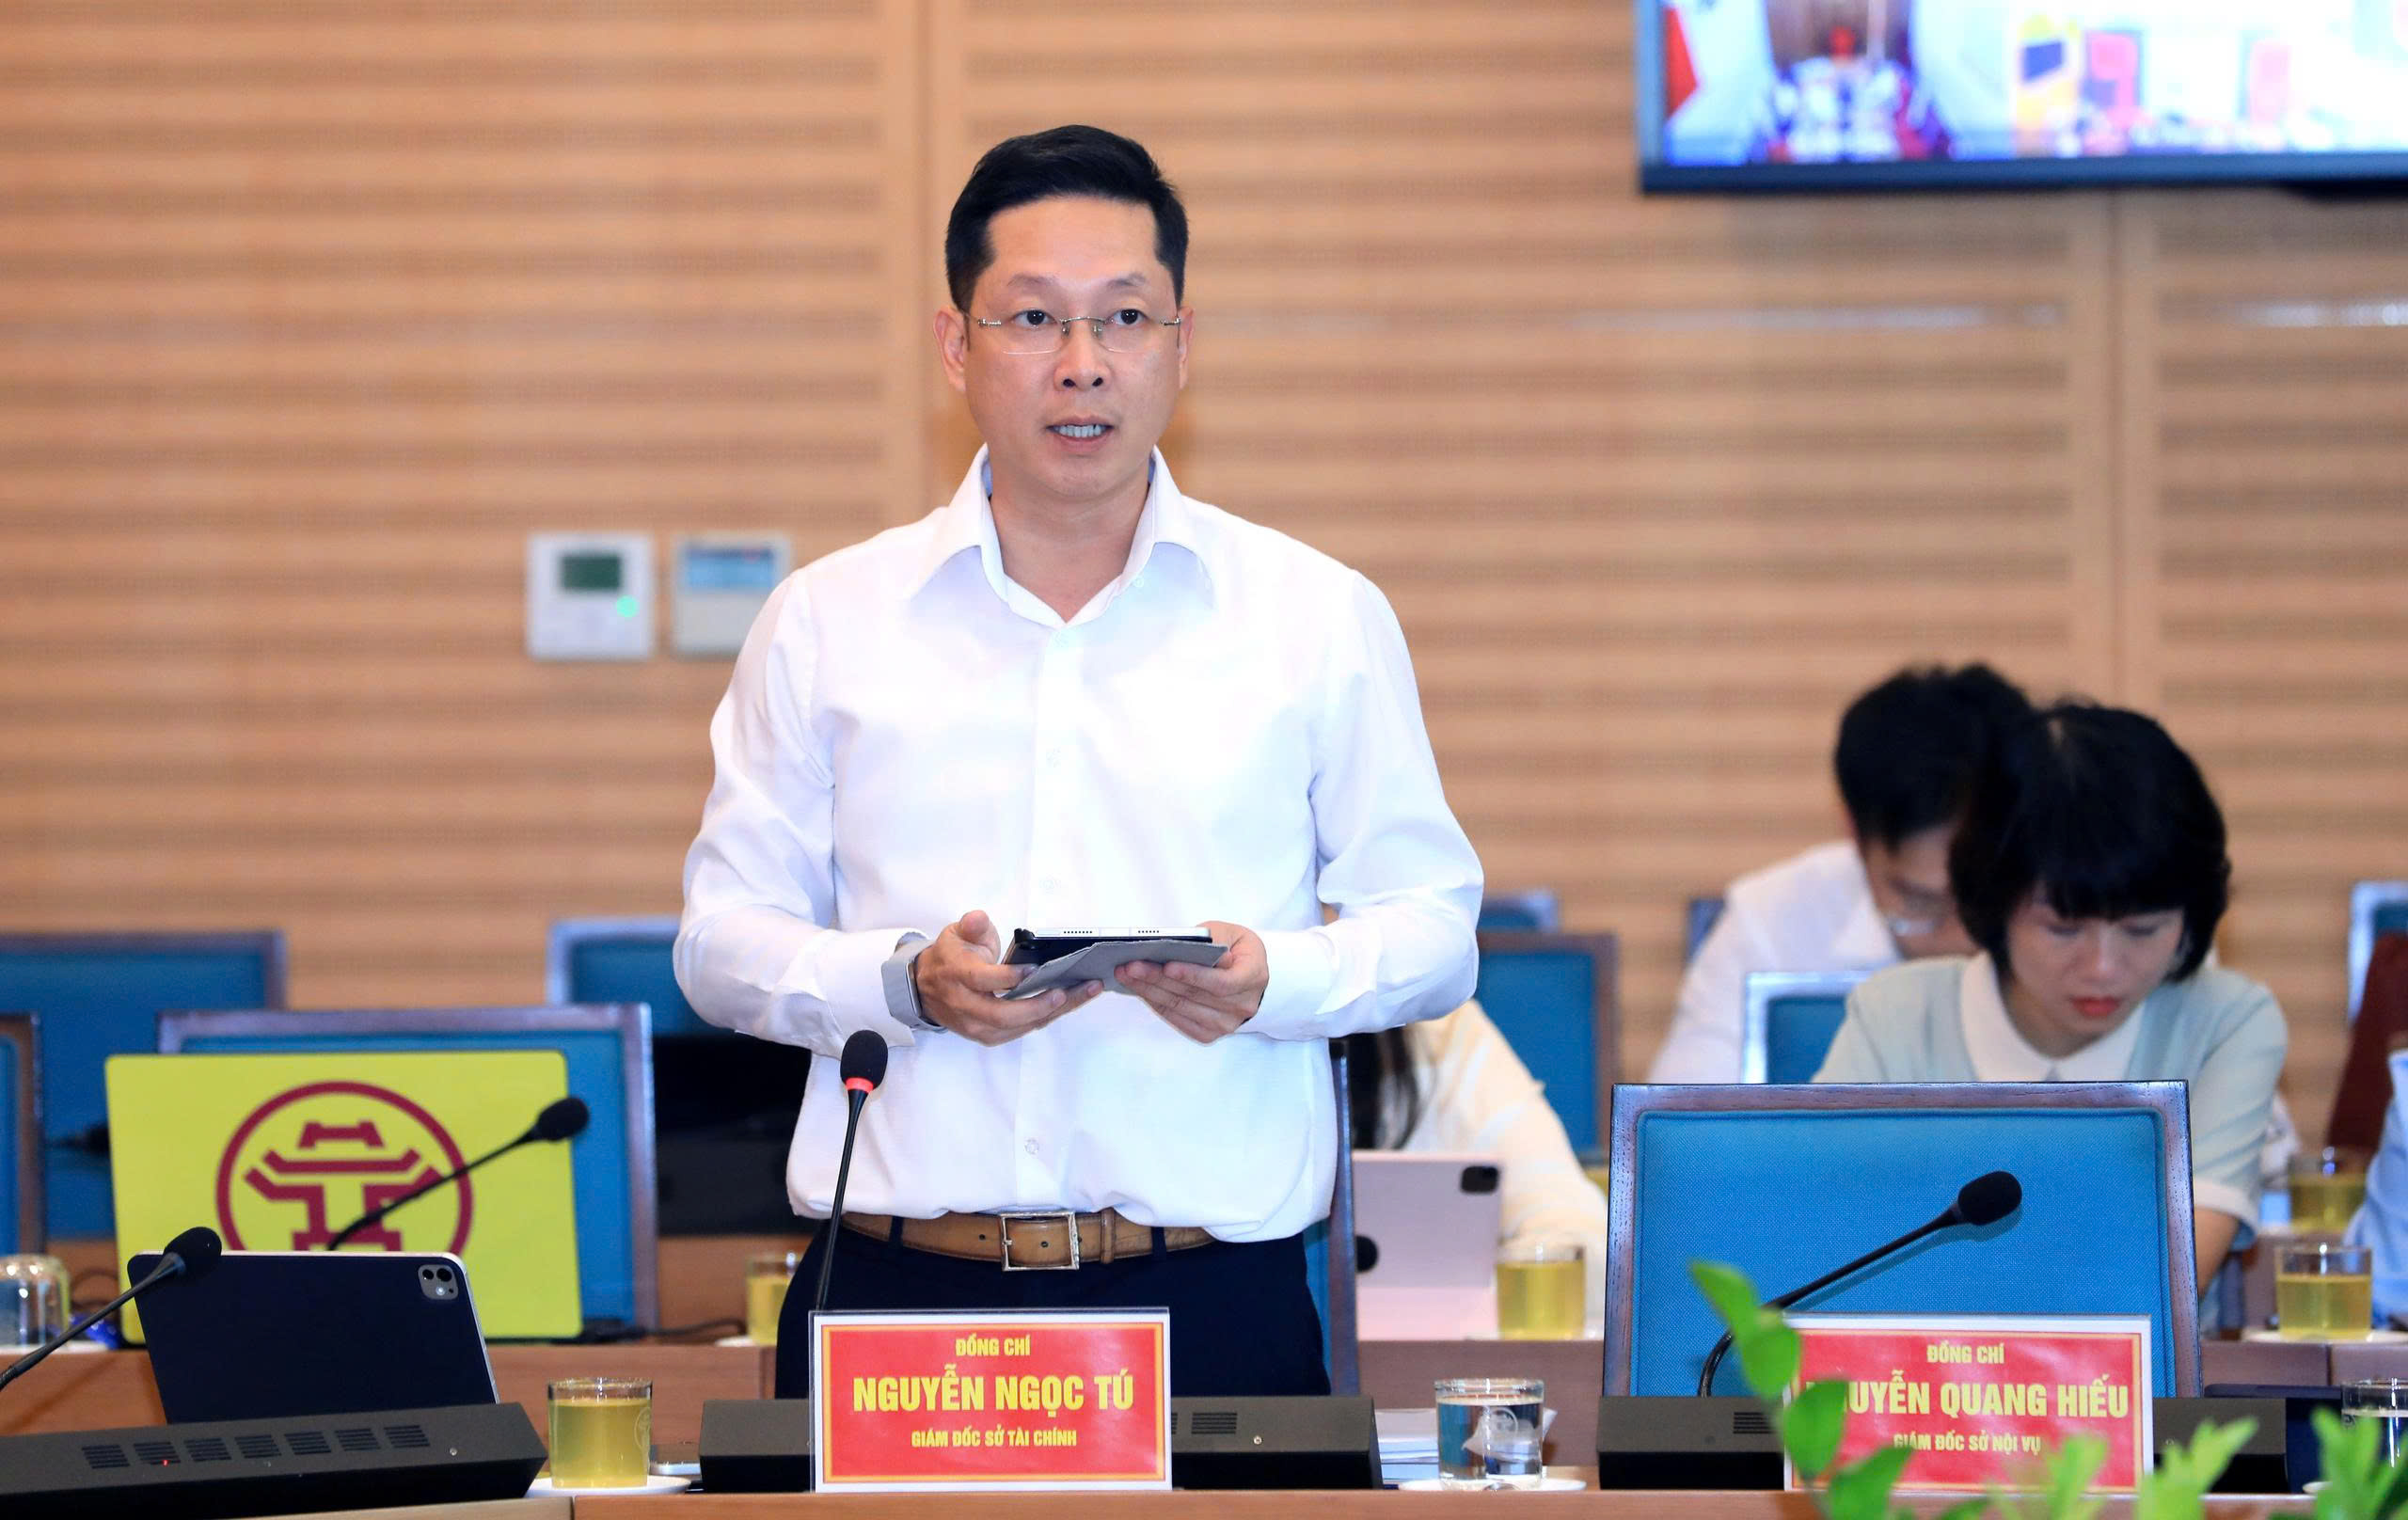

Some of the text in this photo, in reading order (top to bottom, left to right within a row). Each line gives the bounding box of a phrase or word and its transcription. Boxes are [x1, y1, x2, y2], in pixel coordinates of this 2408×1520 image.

[1004, 1334, 1031, 1356] CHÍ
[1977, 1342, 2005, 1364] CHÍ
[853, 1363, 1133, 1417] NGUYỄN NGỌC TÚ
[1806, 1370, 2129, 1418] UYỄN QUANG HIẾU
[911, 1424, 1077, 1448] GIÁM ĐỐC SỞ TÀI CHÍNH
[1893, 1430, 2041, 1455] GIÁM ĐỐC SỞ NỘI VỤ
